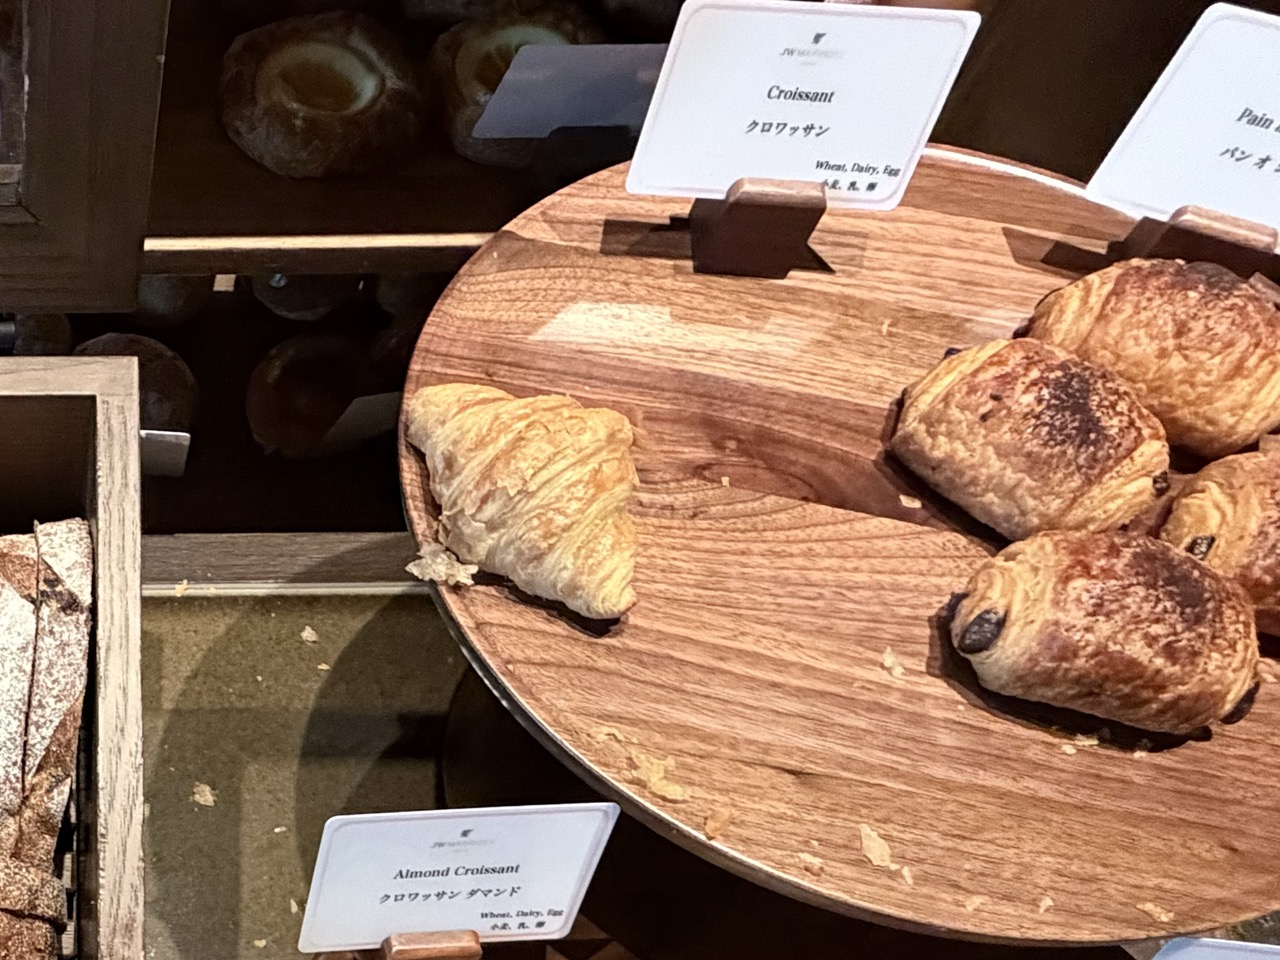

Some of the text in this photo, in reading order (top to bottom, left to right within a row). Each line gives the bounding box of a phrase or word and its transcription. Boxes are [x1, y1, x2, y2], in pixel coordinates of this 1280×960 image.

[767, 84, 835, 103] Croissant
[1235, 106, 1275, 130] Pain
[745, 119, 831, 138] クロワッサン
[815, 160, 902, 178] Wheat, Dairy, Egg
[393, 863, 521, 880] Almond Croissant
[379, 885, 522, 904] クロワッサン ダマンド
[480, 911, 513, 919] Wheat,
[516, 909, 544, 918] Dairy,
